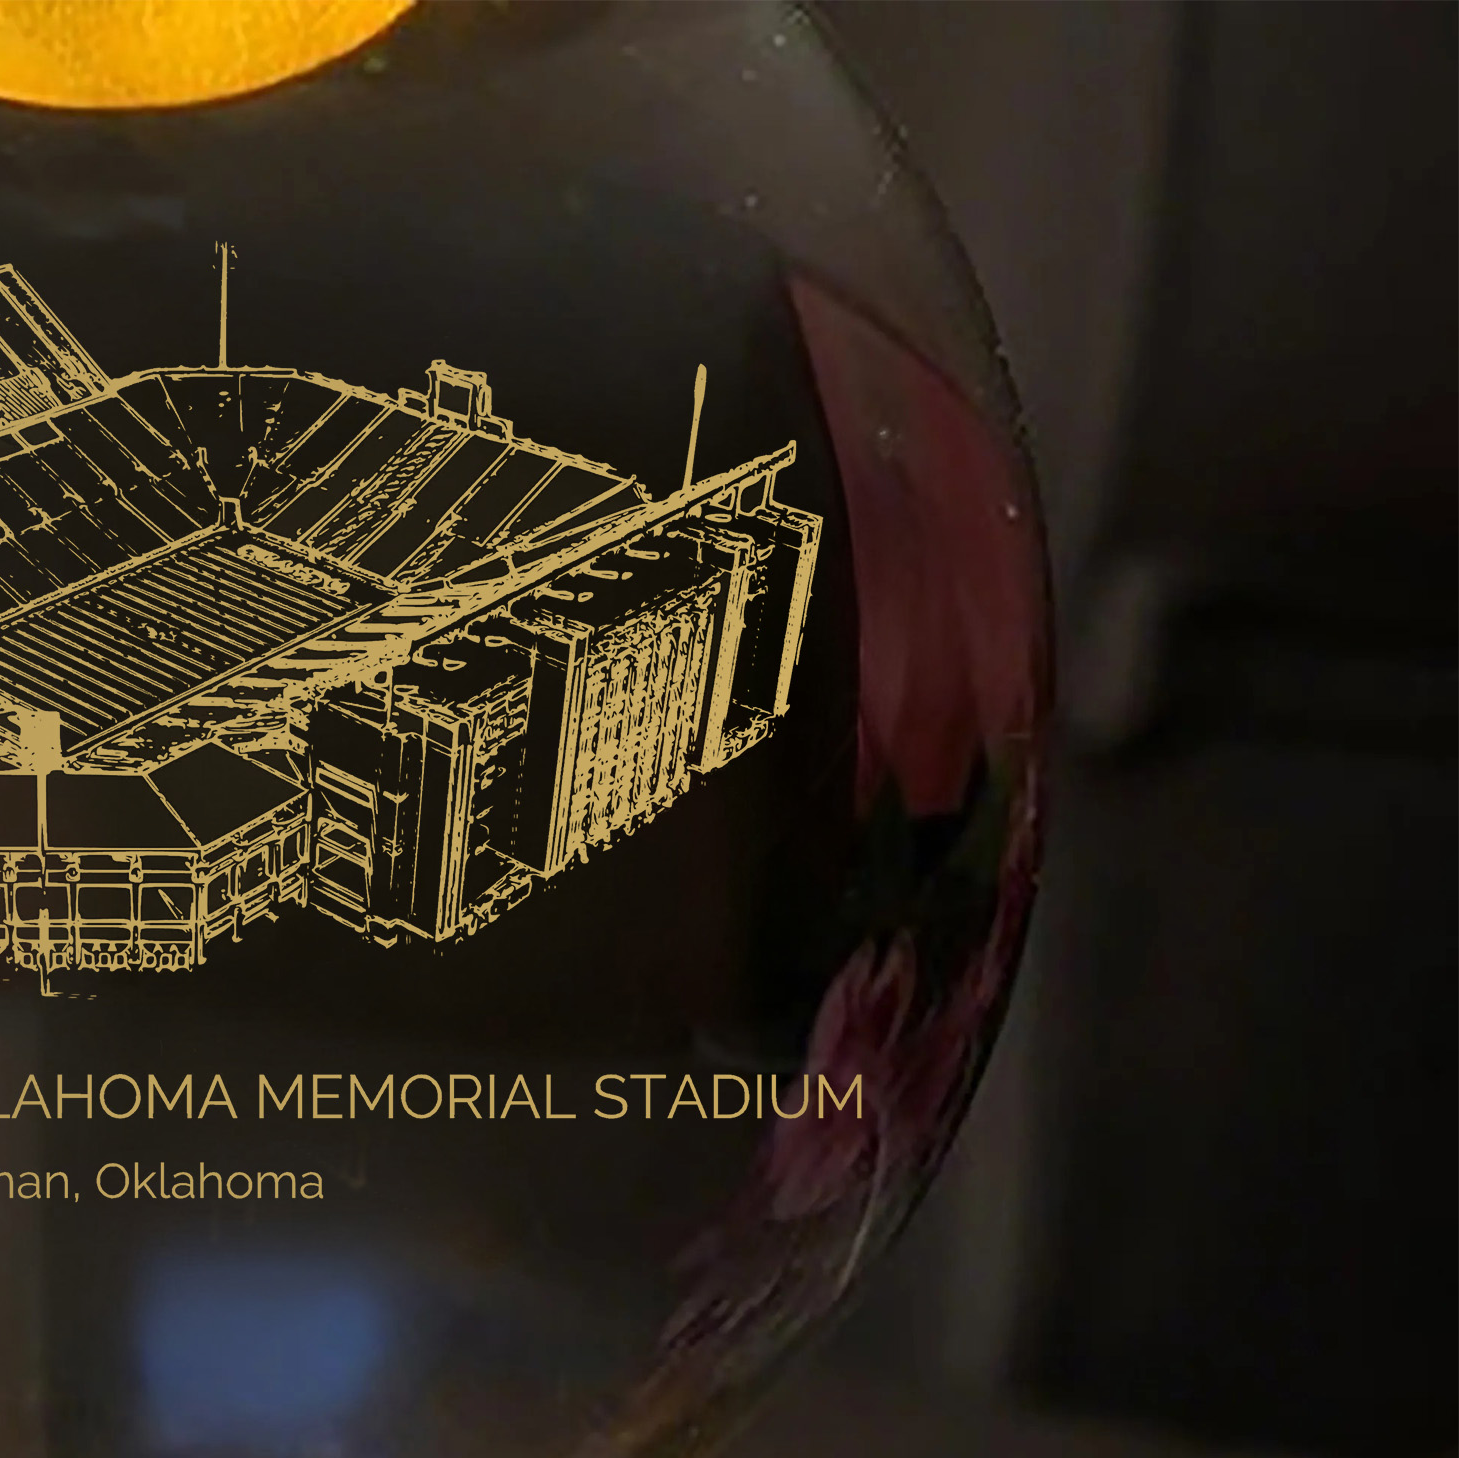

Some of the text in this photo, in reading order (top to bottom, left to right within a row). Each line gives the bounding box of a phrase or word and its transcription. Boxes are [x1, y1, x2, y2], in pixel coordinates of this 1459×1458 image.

[258, 1074, 577, 1120] MEMORIAL
[594, 1074, 866, 1120] STADIUM
[95, 1161, 325, 1200] Oklahoma
